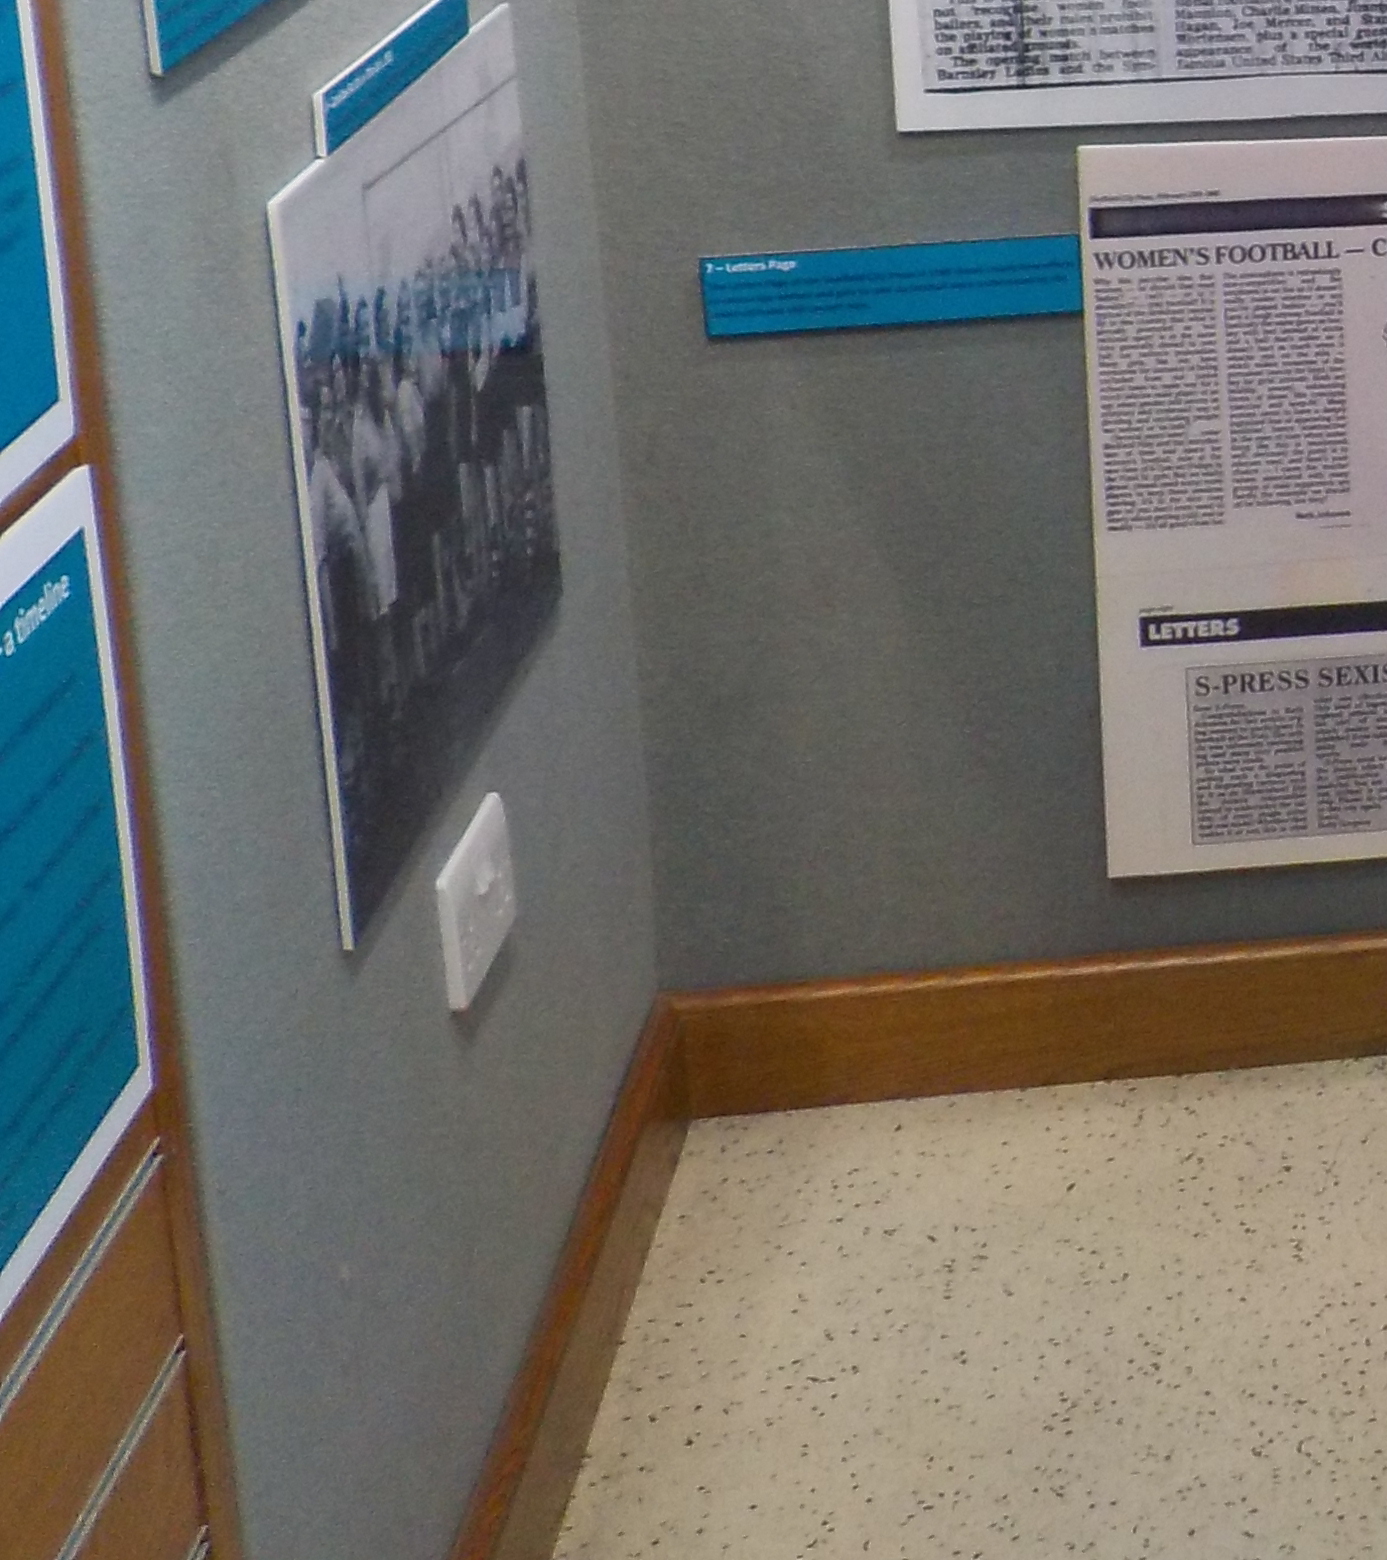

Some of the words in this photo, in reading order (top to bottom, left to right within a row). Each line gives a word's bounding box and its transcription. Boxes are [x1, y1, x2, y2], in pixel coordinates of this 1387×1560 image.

[937, 67, 997, 82] Barnsley
[726, 260, 766, 273] Letters
[768, 258, 797, 272] Page
[1093, 247, 1210, 271] WOMEN'S
[1214, 240, 1340, 266] FOOTBALL
[14, 574, 71, 645] timeline
[1147, 618, 1240, 641] LETTERS
[1194, 671, 1310, 697] S-PRESS
